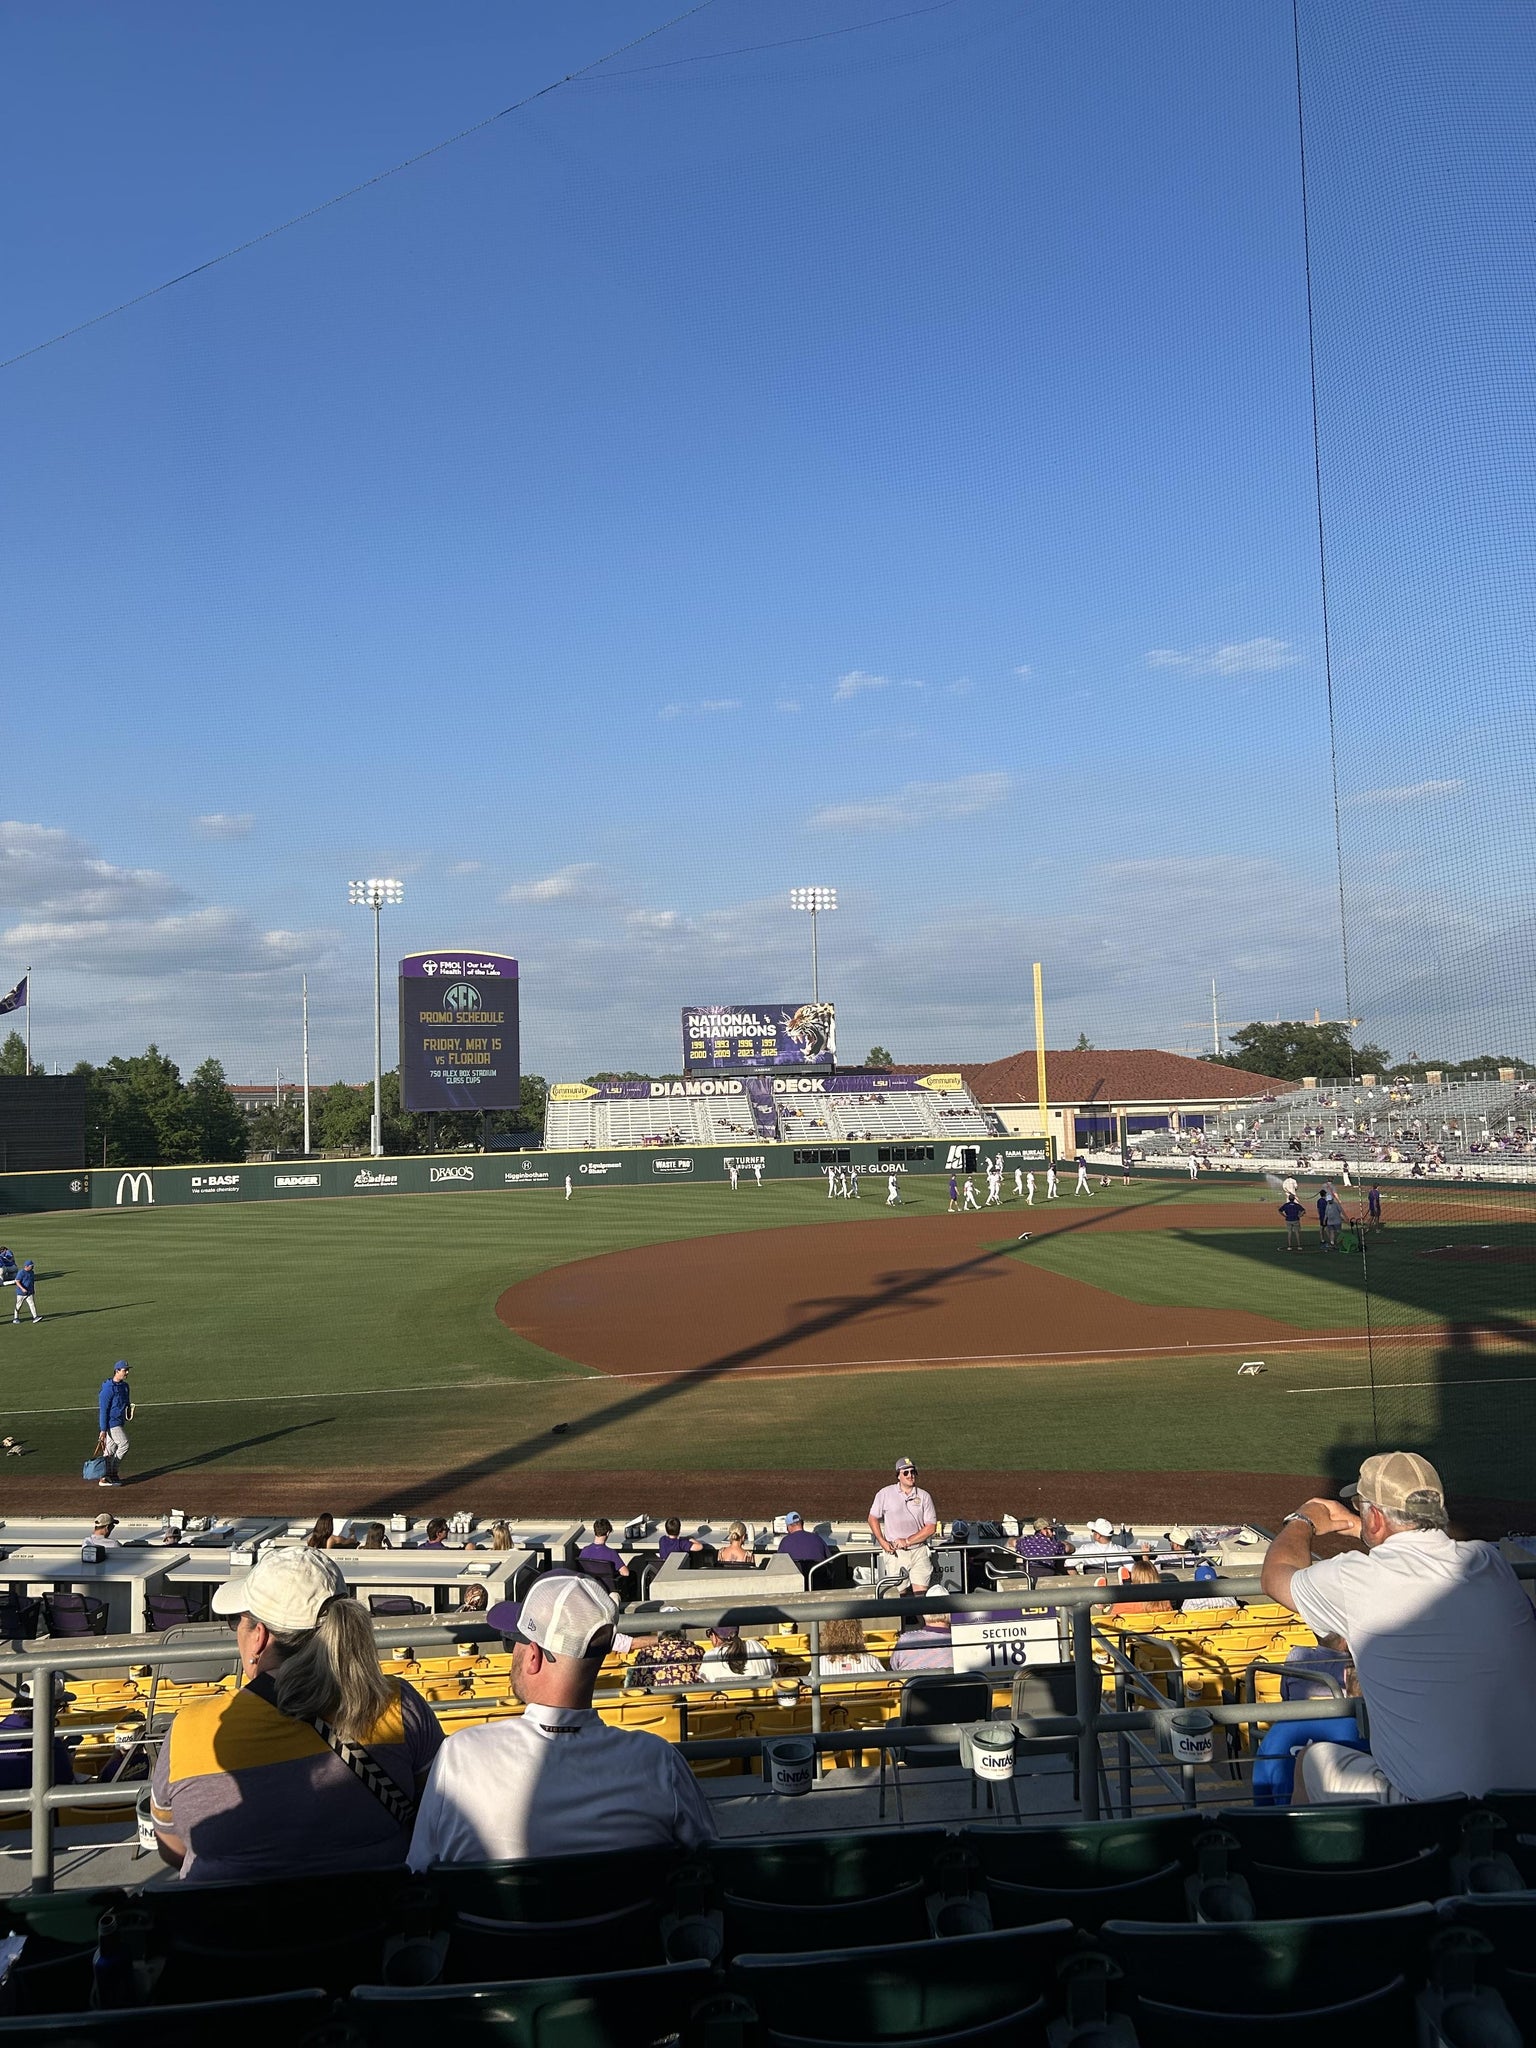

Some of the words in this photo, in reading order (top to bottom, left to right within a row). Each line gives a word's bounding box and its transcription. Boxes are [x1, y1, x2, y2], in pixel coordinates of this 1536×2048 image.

[440, 961, 461, 969] FMOL
[480, 962, 495, 970] Lady
[446, 986, 478, 1010] SEC
[419, 1011, 452, 1023] PROMO
[456, 1011, 504, 1023] SCHEDULE
[688, 1013, 760, 1027] NATIONAL
[689, 1024, 777, 1039] CHAMPIONS
[423, 1038, 462, 1051] FRIDAY,
[466, 1038, 488, 1050] MAY
[491, 1038, 502, 1050] 15
[691, 1040, 705, 1050] 1991
[448, 1052, 491, 1065] FLORIDA
[690, 1050, 707, 1059] 2000
[443, 1069, 458, 1077] ALEX
[459, 1069, 471, 1077] BOX
[471, 1069, 497, 1077] STADIUM
[650, 1080, 742, 1097] DIAMOND
[773, 1079, 826, 1093] DECK
[655, 1160, 677, 1169] WASTE
[735, 1156, 765, 1164] TURNER
[588, 1162, 622, 1170] Equipment
[821, 1164, 867, 1174] VENTURE
[868, 1163, 908, 1174] GLOBAL
[353, 1173, 398, 1184] Acadian
[429, 1166, 474, 1182] DRAGO'S
[504, 1172, 549, 1180] Higginbotham
[208, 1175, 239, 1186] BASF
[276, 1176, 318, 1186] BADGER
[982, 1626, 1028, 1639] SECTION
[985, 1640, 1027, 1667] 118
